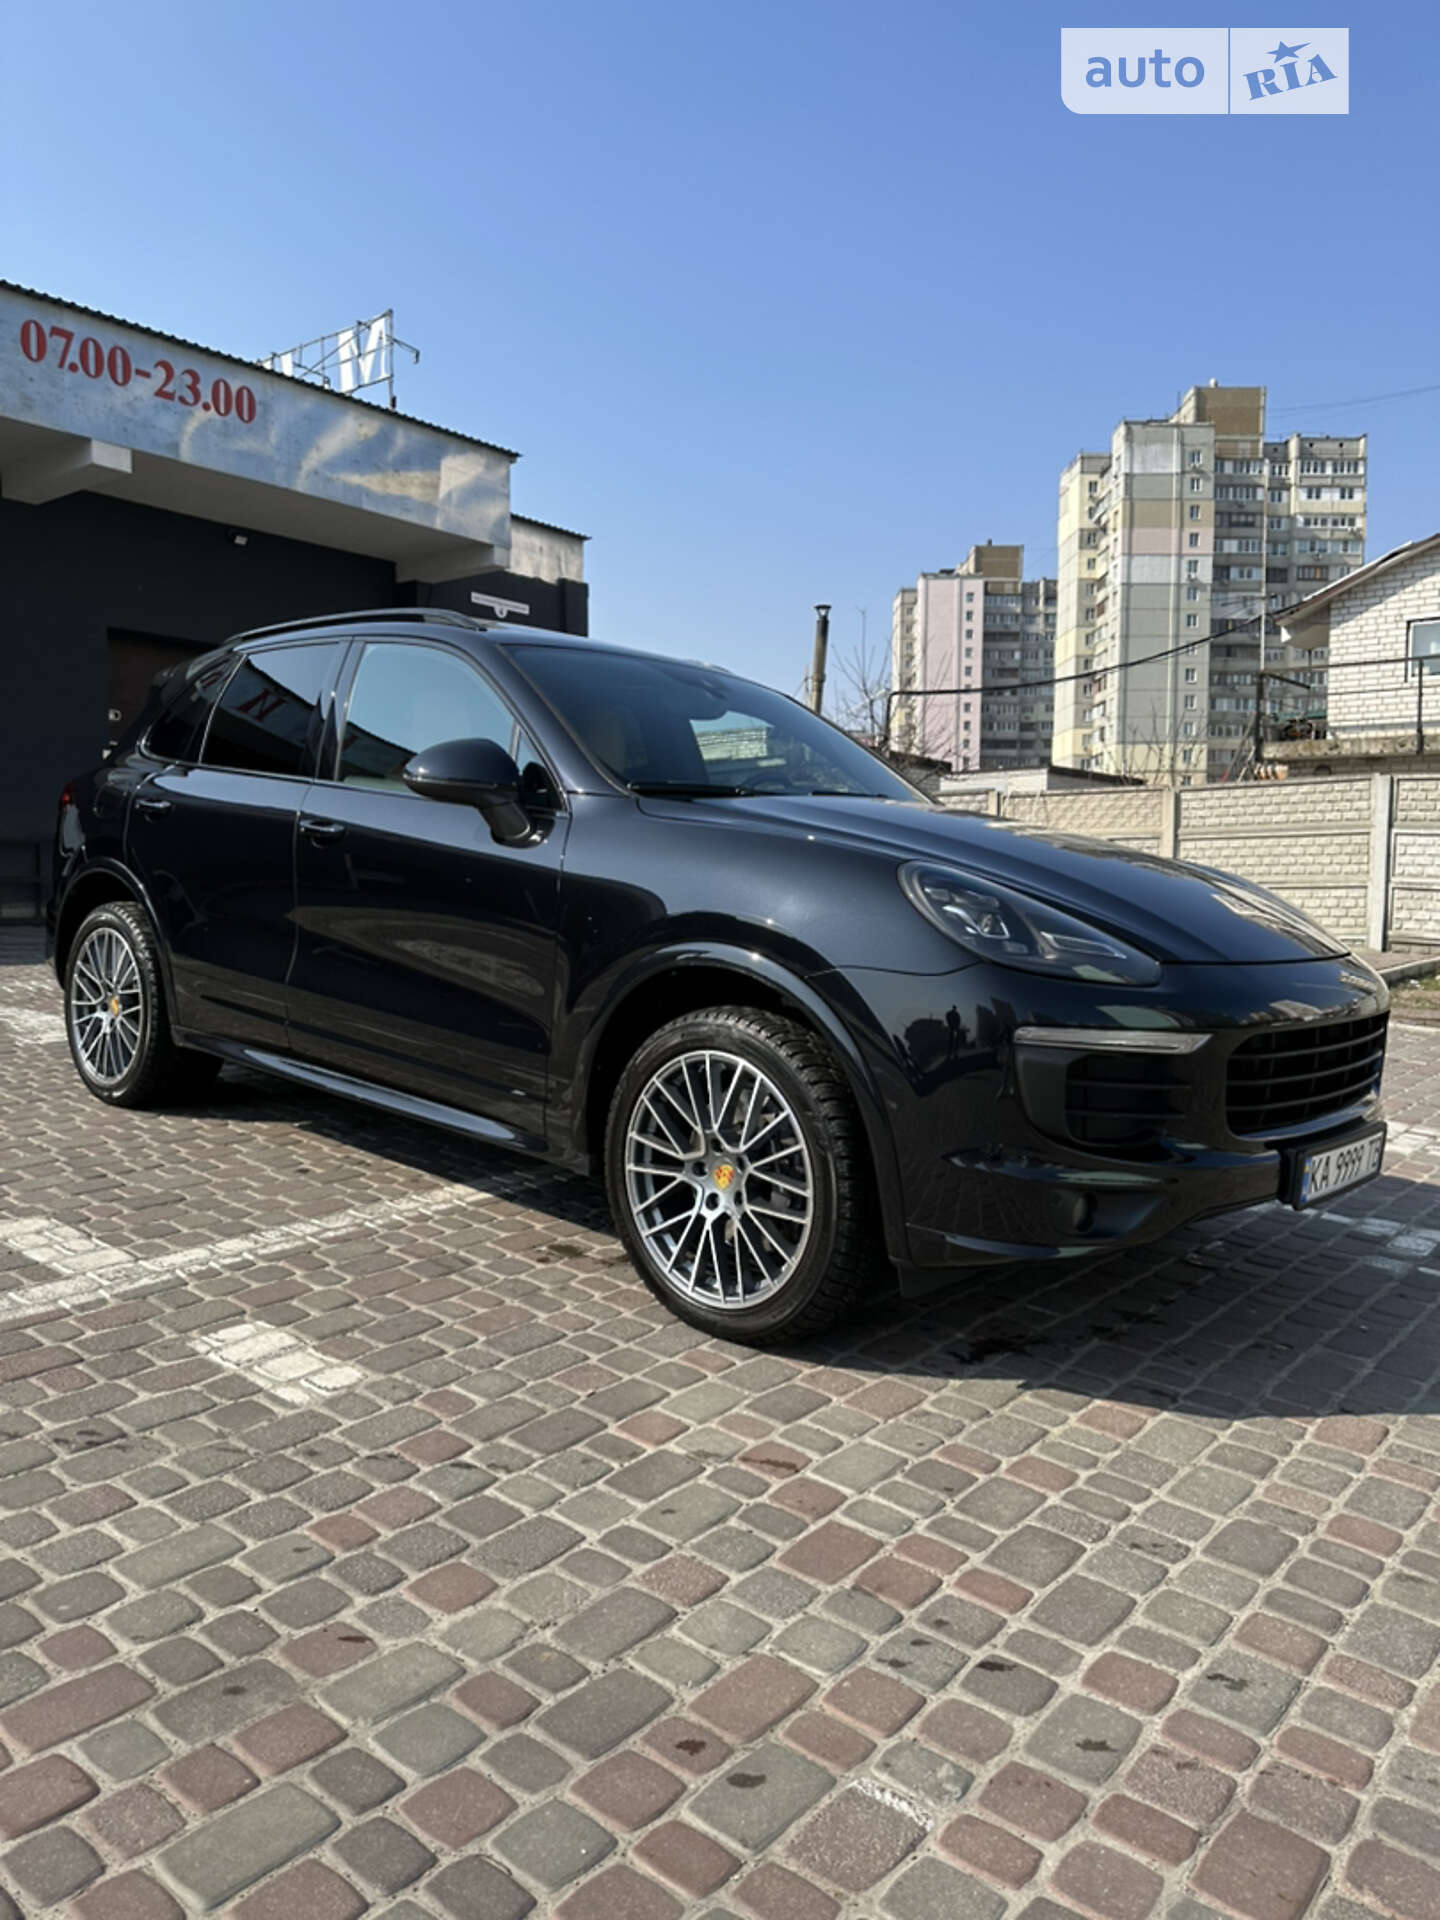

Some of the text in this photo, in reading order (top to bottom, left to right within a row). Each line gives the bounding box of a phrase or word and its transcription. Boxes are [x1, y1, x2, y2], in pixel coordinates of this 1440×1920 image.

[20, 320, 256, 424] 07.00-23.00
[1311, 1154, 1331, 1193] KA
[1333, 1145, 1365, 1185] 9999
